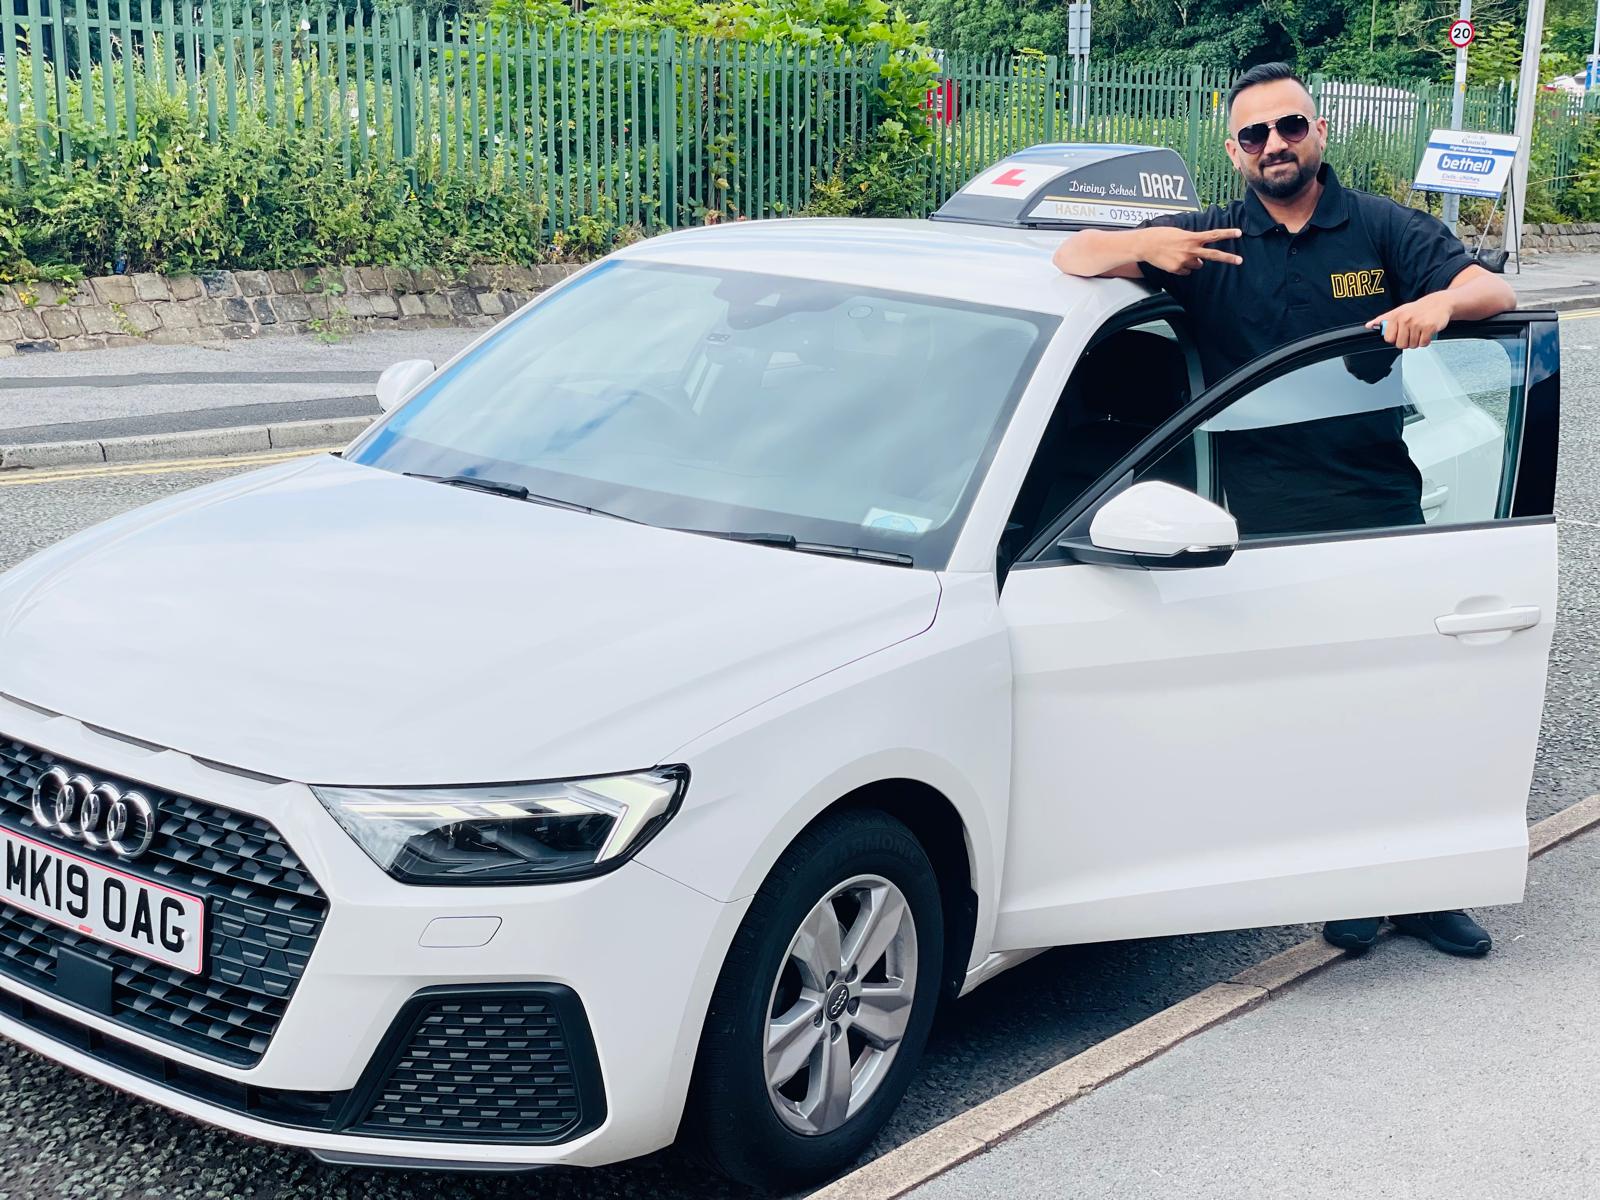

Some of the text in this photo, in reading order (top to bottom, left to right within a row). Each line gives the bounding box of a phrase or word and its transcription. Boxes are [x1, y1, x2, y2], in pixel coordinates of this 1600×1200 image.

[1453, 27, 1470, 39] 20
[1442, 156, 1492, 172] bethell
[991, 169, 1025, 187] L
[1069, 172, 1188, 200] Driving School DARZ
[1055, 204, 1096, 217] HASAN
[1109, 208, 1143, 221] 07933
[1331, 269, 1384, 298] DARZ
[6, 839, 186, 953] MK19 OAG
